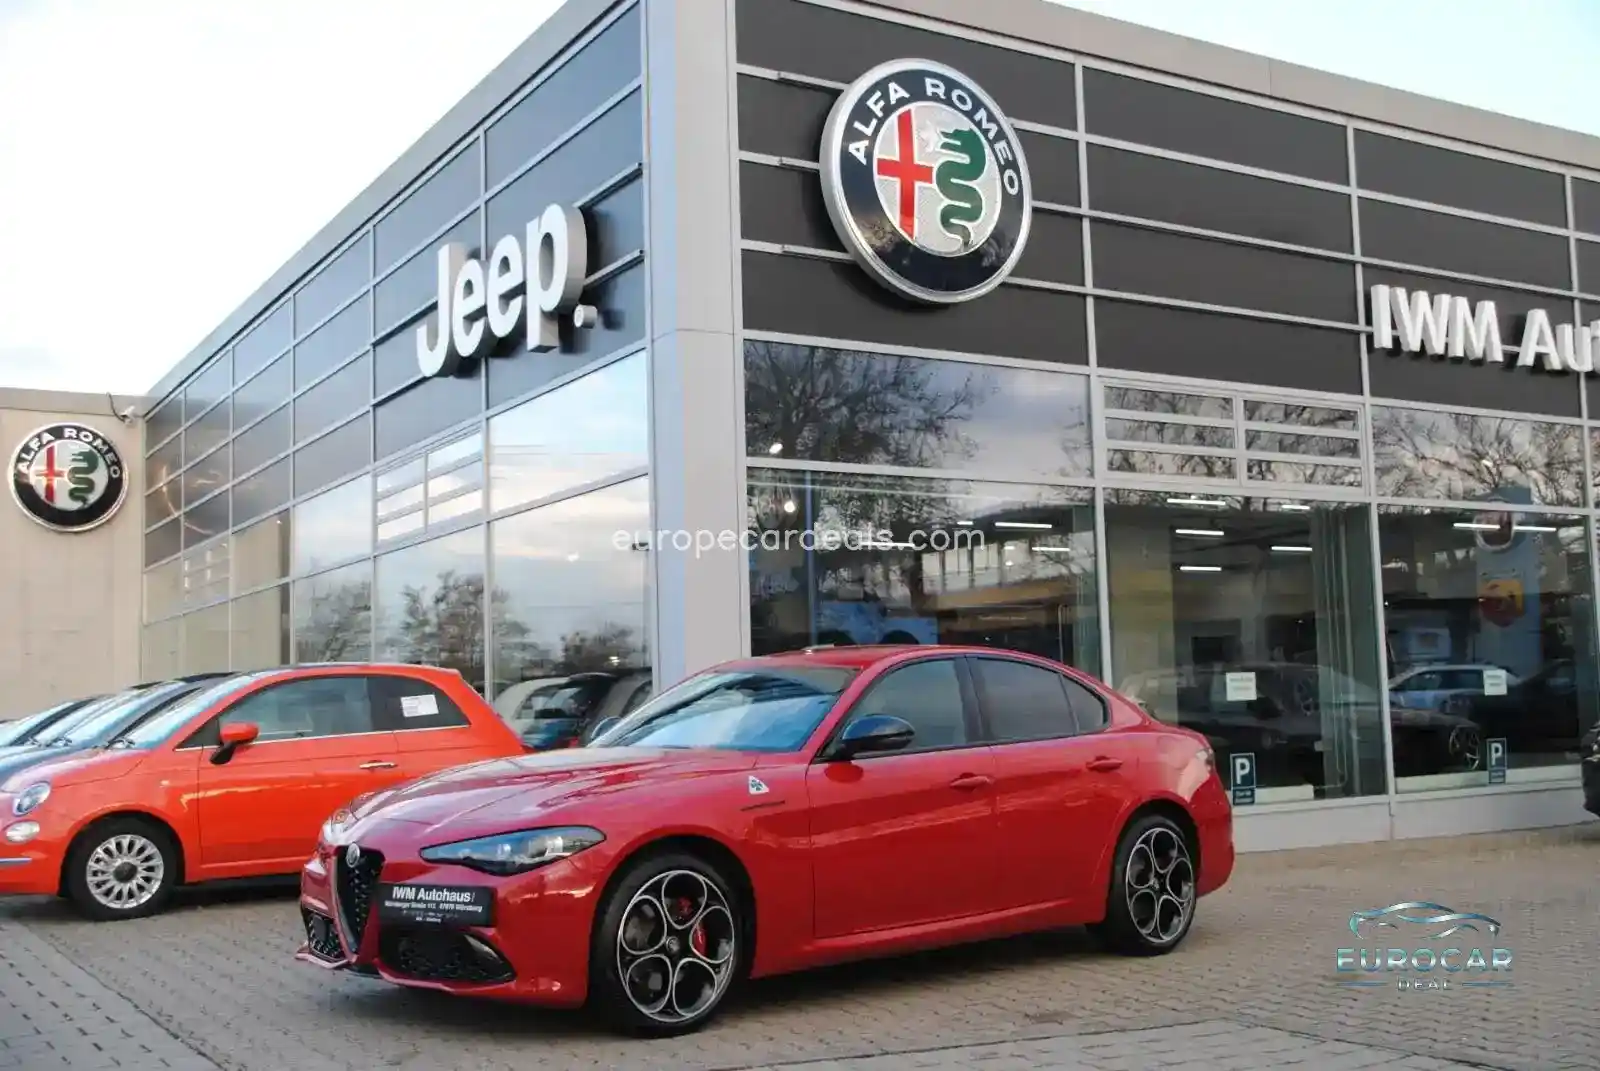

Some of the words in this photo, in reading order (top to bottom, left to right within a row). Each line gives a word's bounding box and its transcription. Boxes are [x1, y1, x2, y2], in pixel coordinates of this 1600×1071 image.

[848, 81, 911, 166] ALFA
[923, 77, 1020, 196] ROMEO
[1370, 284, 1504, 363] IWM
[18, 432, 56, 475] ALFA
[63, 427, 121, 478] ROMEO
[1234, 757, 1250, 785] P
[1491, 742, 1502, 766] P
[392, 886, 416, 900] IWM
[417, 887, 471, 903] Autohaus
